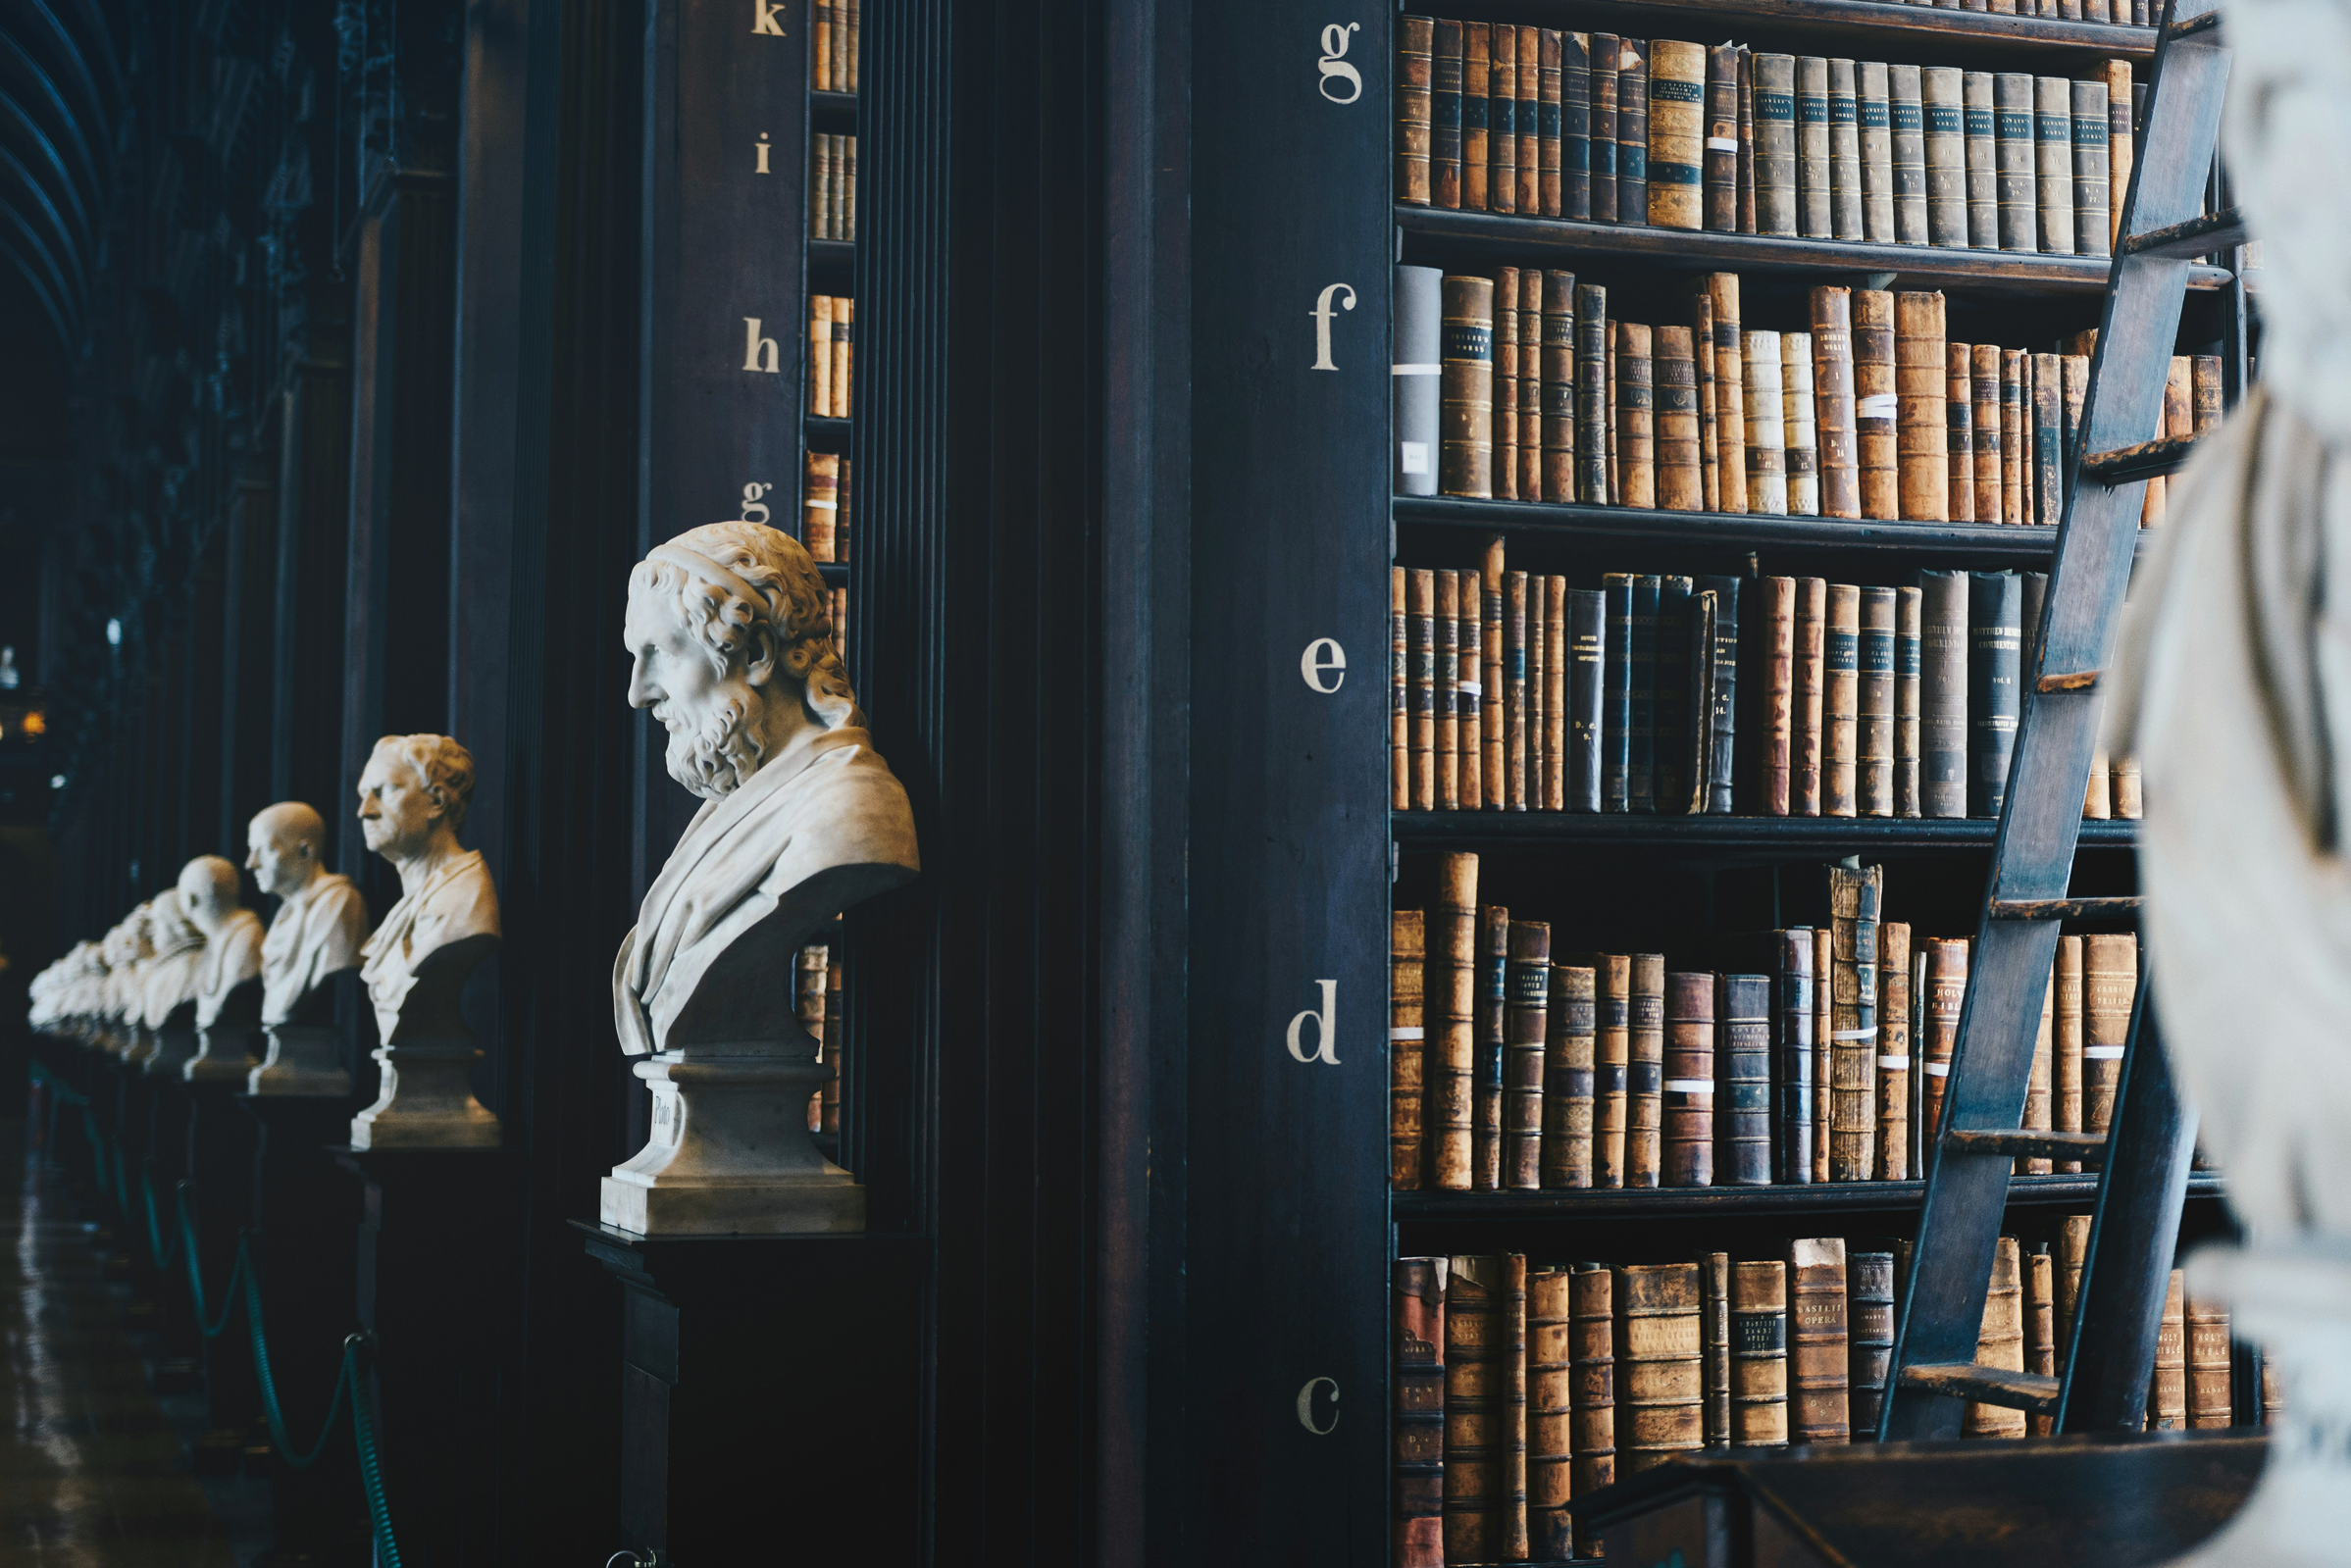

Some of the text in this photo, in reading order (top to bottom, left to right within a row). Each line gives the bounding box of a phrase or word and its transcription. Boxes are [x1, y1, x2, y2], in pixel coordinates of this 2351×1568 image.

[751, 0, 787, 36] k
[1317, 22, 1362, 105] g
[755, 132, 772, 175] i
[1308, 282, 1357, 372] f
[742, 317, 781, 374] h
[741, 481, 772, 523] g
[1972, 627, 2003, 635] MATTHEW
[1978, 640, 2019, 650] COMMENTARY
[1301, 637, 1347, 694] e
[1937, 988, 1963, 997] HOLY
[1931, 1001, 1959, 1010] BIBL
[1286, 979, 1342, 1065] d
[654, 1095, 671, 1125] Plato
[1798, 1303, 1842, 1313] BASILII
[1805, 1316, 1837, 1325] OPERA
[2159, 1333, 2177, 1341] HOLY
[2198, 1333, 2221, 1341] HOLY
[2156, 1345, 2180, 1354] BIBLE
[2195, 1346, 2225, 1355] BIBLE
[1297, 1376, 1340, 1436] c
